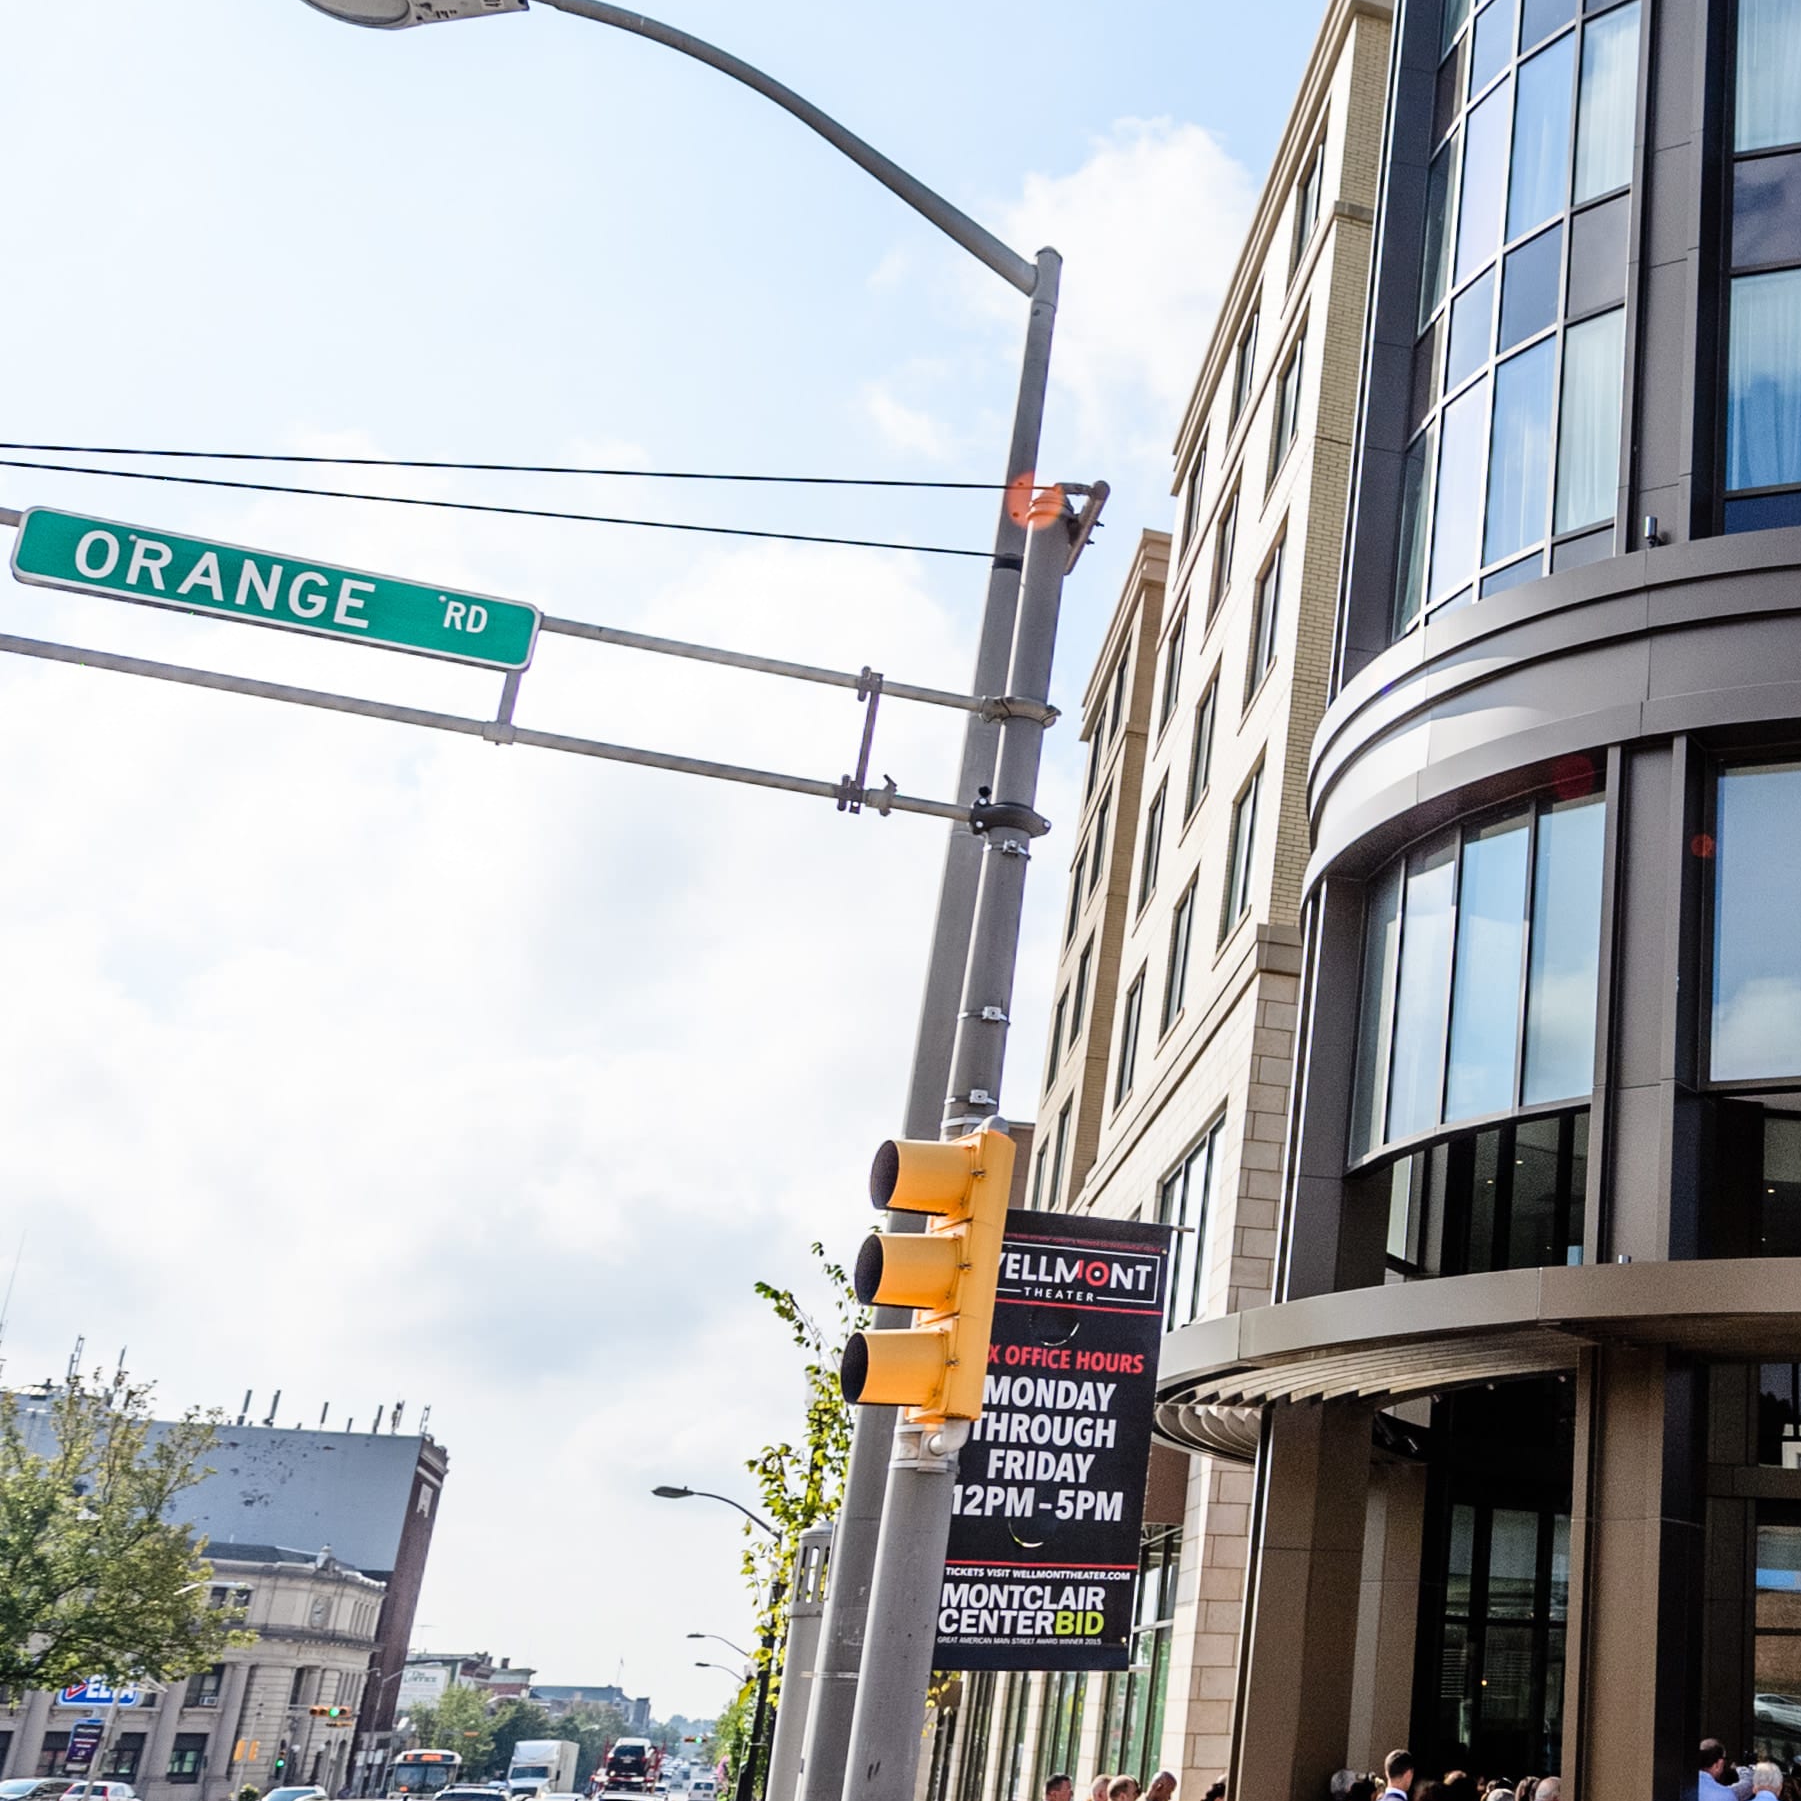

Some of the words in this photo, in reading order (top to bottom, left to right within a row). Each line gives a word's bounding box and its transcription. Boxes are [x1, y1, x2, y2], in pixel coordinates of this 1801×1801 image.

[74, 530, 376, 629] ORANGE
[442, 600, 488, 634] RD
[1023, 1286, 1094, 1302] THEATER
[1005, 1345, 1072, 1370] OFFICE
[1076, 1350, 1145, 1374] HOURS
[982, 1374, 1117, 1412] MONDAY
[972, 1410, 1117, 1449] THROUGH
[987, 1449, 1096, 1484] FRIDAY
[945, 1567, 985, 1577] TICKETS
[986, 1568, 1010, 1578] VISIT
[1012, 1569, 1131, 1581] WELLMONTTHEATER.COM
[941, 1583, 1106, 1611] MONTCLAIR
